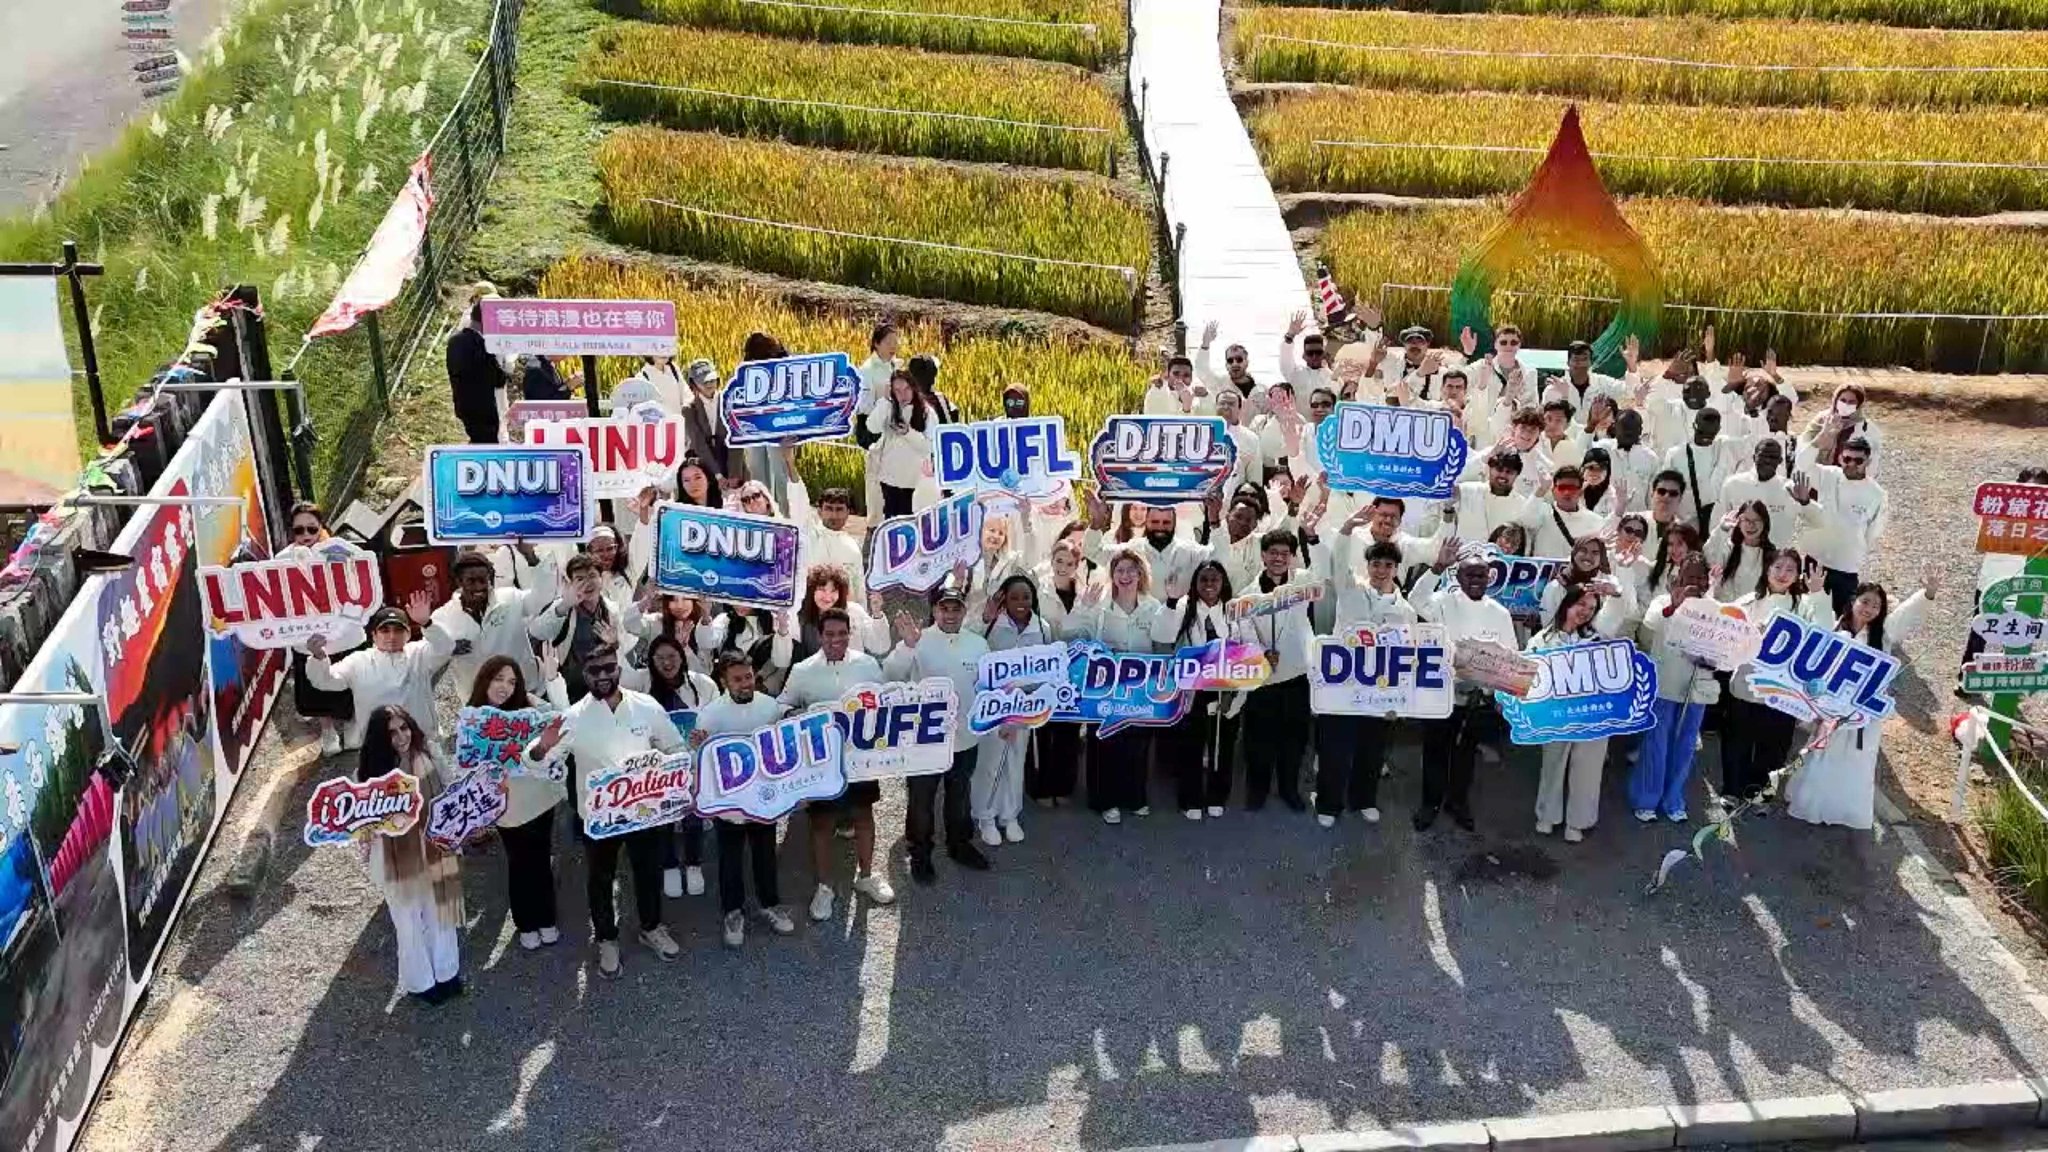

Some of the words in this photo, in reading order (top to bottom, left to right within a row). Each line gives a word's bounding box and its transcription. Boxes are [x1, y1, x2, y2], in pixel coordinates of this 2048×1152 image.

[496, 308, 666, 329] 等待浪漫也在等你
[745, 360, 836, 405] DJTU
[940, 423, 1074, 483] DUFL
[1116, 421, 1212, 463] DJTU
[1340, 407, 1449, 460] DMU
[456, 459, 561, 495] DNUI
[679, 519, 777, 564] DNUI
[887, 494, 976, 570] DUT
[205, 559, 374, 623] LNNU
[1982, 618, 2044, 639] 卫生间
[988, 654, 1060, 691] iDalian
[1083, 656, 1178, 702] DPU
[1320, 644, 1444, 689] DUFE
[1756, 615, 1893, 713] DUFL
[980, 694, 1046, 719] iDalian
[625, 752, 658, 773] 2026
[716, 713, 832, 791] DUT
[321, 796, 330, 824] i
[333, 788, 414, 826] Dalian
[607, 769, 686, 808] Dalian
